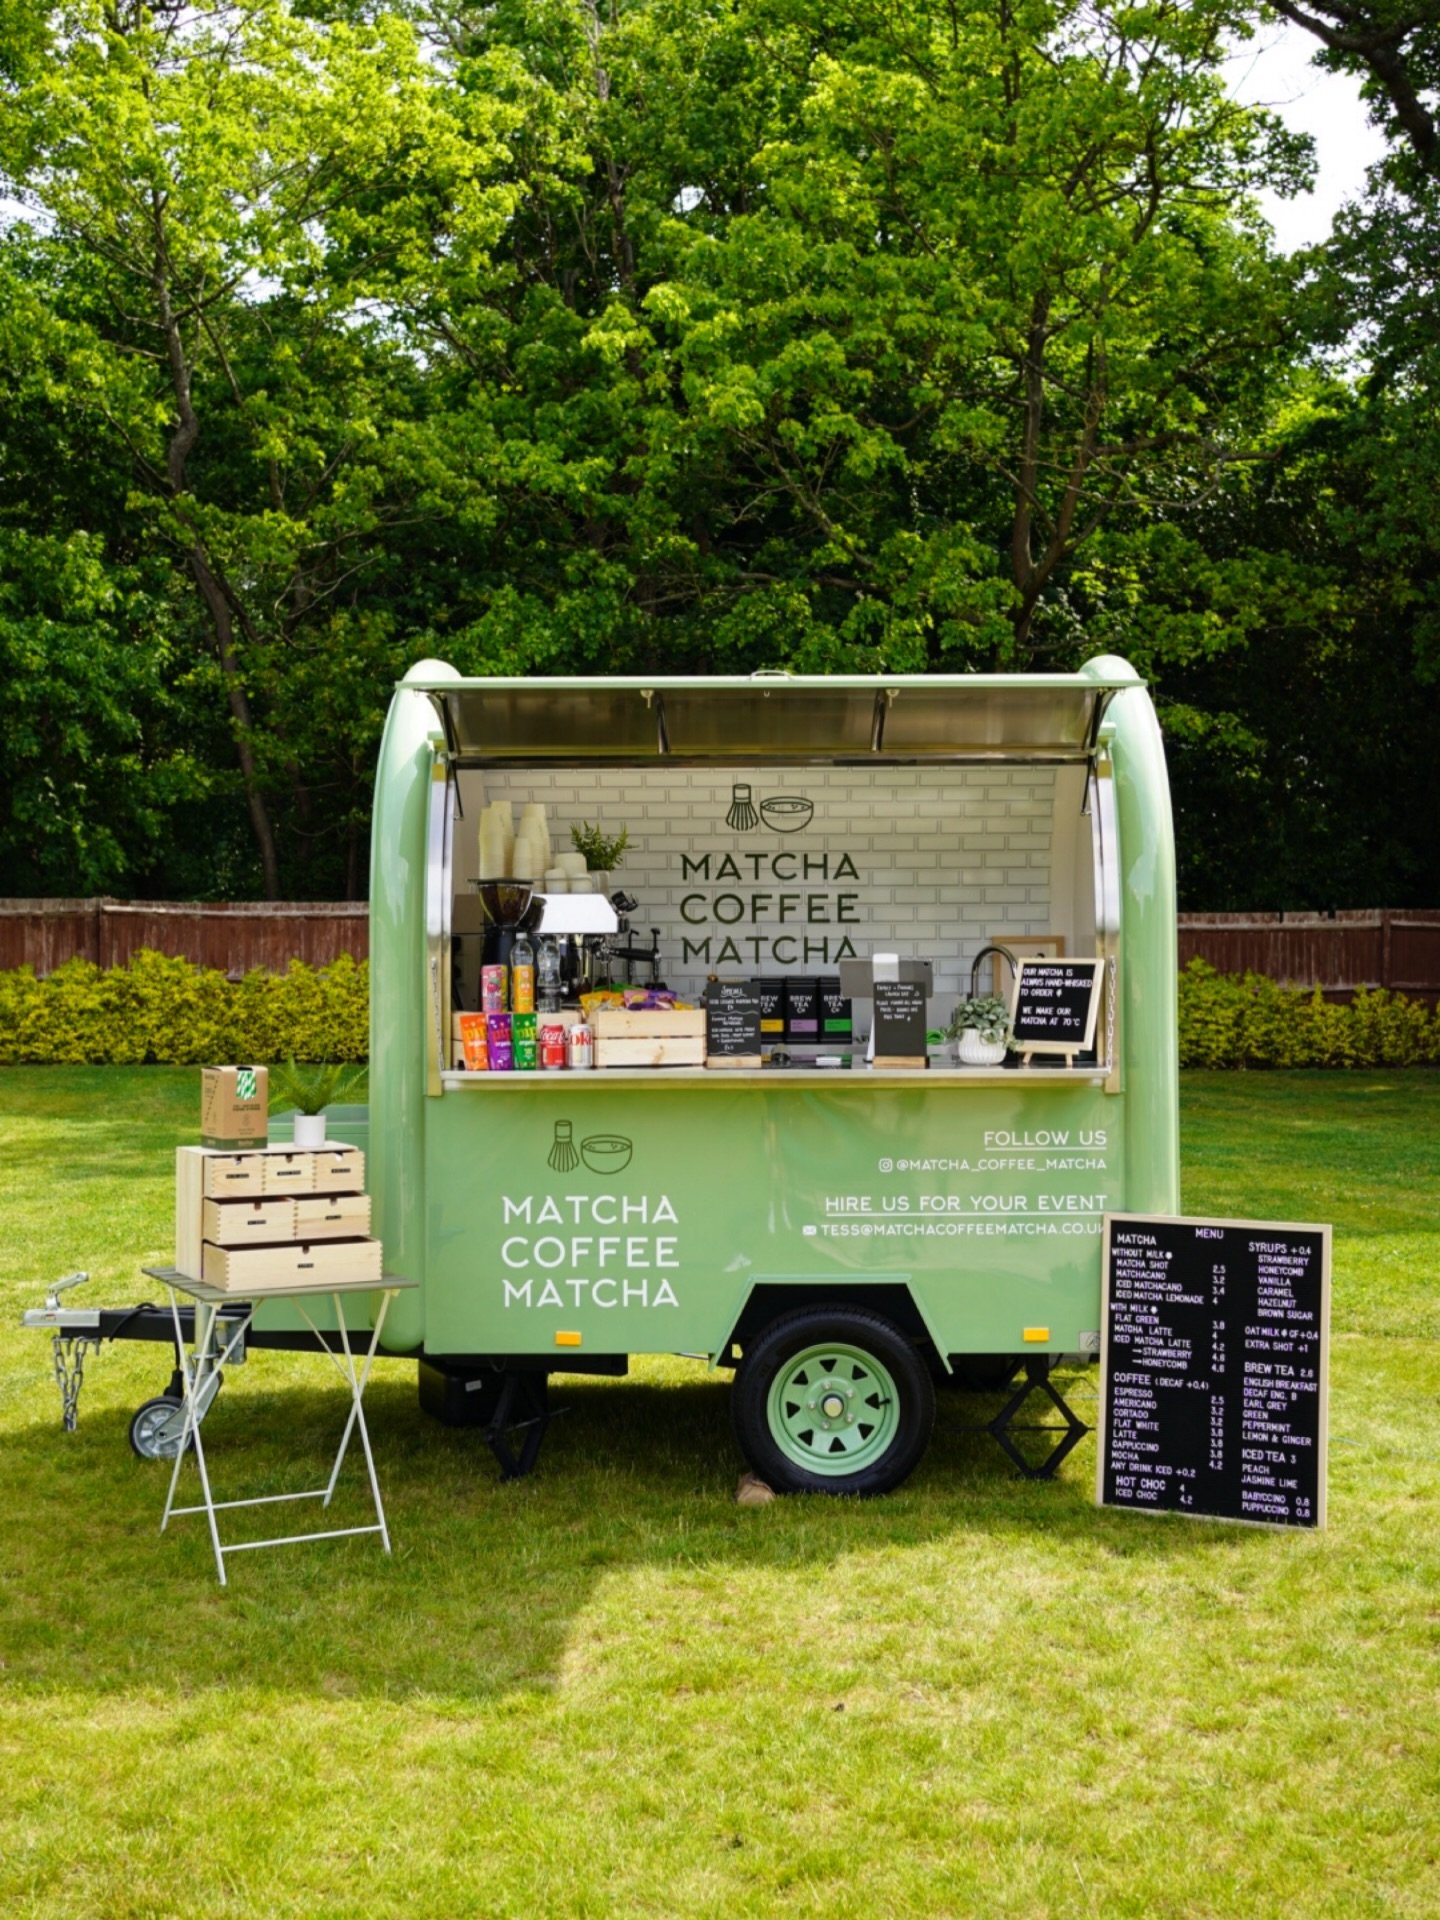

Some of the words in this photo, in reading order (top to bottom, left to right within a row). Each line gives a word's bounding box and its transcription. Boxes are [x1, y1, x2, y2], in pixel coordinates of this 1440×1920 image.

[680, 853, 860, 880] MATCHA
[680, 893, 861, 925] COFFEE
[681, 935, 858, 965] MATCHA
[1037, 968, 1063, 977] MATCHA
[1066, 969, 1073, 977] IS
[1022, 978, 1044, 986] ALWAYS
[1021, 988, 1029, 996] TO
[1030, 988, 1054, 997] ORDER
[1022, 1006, 1033, 1014] WE
[1036, 1006, 1054, 1015] MAKE
[1056, 1007, 1072, 1016] OUR
[1021, 1017, 1047, 1025] MATCHA
[1049, 1017, 1059, 1026] AT
[983, 1130, 1070, 1146] FOLLOW
[1079, 1130, 1107, 1146] US
[896, 1158, 1107, 1172] @MATCHA_COFFEE_MATCHA
[502, 1195, 679, 1224] MATCHA
[825, 1196, 872, 1212] HIRE
[882, 1196, 910, 1211] US
[919, 1196, 961, 1211] FOR
[970, 1196, 1028, 1211] YOUR
[1038, 1195, 1107, 1211] EVENT
[1117, 1233, 1157, 1245] MATCHA
[1195, 1227, 1224, 1239] MENU
[501, 1236, 680, 1268] COFFEE
[1111, 1247, 1143, 1257] WITHOUT
[1146, 1250, 1164, 1259] MILK
[1248, 1241, 1287, 1254] SYRUPS
[1116, 1259, 1146, 1268] MATCHA
[1149, 1261, 1169, 1270] SHOT
[1258, 1254, 1309, 1266] STRAWBERRY
[1116, 1269, 1166, 1280] MATCHACANO
[1258, 1265, 1304, 1277] HONEYCOMB
[1115, 1280, 1132, 1289] ICED
[1134, 1281, 1183, 1292] MATCHACANO
[1258, 1275, 1291, 1286] VANILLA
[502, 1278, 680, 1308] MATCHA
[1115, 1290, 1132, 1299] ICED
[1133, 1291, 1163, 1301] MATCHA
[1165, 1293, 1204, 1304] LEMONADE
[1212, 1296, 1218, 1305] 4
[1257, 1287, 1294, 1298] CARAMEL
[1110, 1303, 1127, 1312] WITH
[1130, 1303, 1149, 1313] MILK
[1258, 1297, 1297, 1308] HAZELNUT
[1115, 1313, 1132, 1322] FLAT
[1135, 1315, 1159, 1325] GREEN
[1257, 1308, 1284, 1318] BROWN
[1286, 1310, 1313, 1320] SUGAR
[1114, 1324, 1143, 1334] MATCHA
[1149, 1326, 1172, 1336] LATTE
[1212, 1331, 1218, 1339] 4
[1244, 1325, 1260, 1335] OAT
[1261, 1327, 1280, 1337] MILK
[1113, 1334, 1130, 1343] ICED
[1134, 1336, 1164, 1346] MATCHA
[1168, 1339, 1192, 1348] LATTE
[1211, 1342, 1225, 1352] 4.2
[1245, 1339, 1270, 1350] EXTRA
[1272, 1341, 1294, 1352] SHOT
[1298, 1343, 1308, 1353] +1
[1142, 1347, 1192, 1359] STRAWBERRY
[1142, 1357, 1188, 1370] HONEYCOMB
[1244, 1361, 1273, 1374] BREW
[1273, 1364, 1295, 1376] TEA
[1113, 1372, 1152, 1385] COFFEE
[1243, 1376, 1274, 1388] ENGLISH
[1275, 1379, 1318, 1392] BREAKFAST
[1114, 1387, 1153, 1398] ESPRESSO
[1243, 1387, 1268, 1398] DECAF
[1113, 1398, 1157, 1409] AMERICANO
[1243, 1398, 1264, 1409] EARL
[1266, 1401, 1288, 1411] GREY
[1113, 1408, 1149, 1419] CORTADO
[1242, 1409, 1269, 1420] GREEN
[1113, 1418, 1132, 1428] FLAT
[1135, 1421, 1159, 1431] WHITE
[1242, 1420, 1291, 1433] PEPPERMINT
[1112, 1429, 1137, 1439] LATTE
[1242, 1431, 1269, 1442] LEMON
[1271, 1434, 1278, 1443] &
[1282, 1435, 1312, 1446] GINGER
[1112, 1440, 1159, 1452] CAPPUCCINO
[1111, 1450, 1139, 1461] MOCHA
[1209, 1460, 1223, 1470] 4.2
[1242, 1448, 1264, 1460] ICED
[1265, 1450, 1286, 1463] TEA
[1290, 1454, 1297, 1464] 3
[1111, 1461, 1126, 1470] ANY
[1129, 1463, 1153, 1473] DRINK
[1155, 1465, 1173, 1475] ICED
[1242, 1463, 1270, 1475] PEACH
[1115, 1475, 1136, 1487] HOT
[1140, 1478, 1166, 1491] CHOC
[1180, 1484, 1185, 1492] 4
[1241, 1474, 1276, 1487] JASMINE
[1279, 1479, 1298, 1490] LIME
[1115, 1488, 1133, 1498] ICED
[1136, 1491, 1158, 1501] CHOC
[1180, 1495, 1193, 1505] 4.2
[1242, 1490, 1286, 1504] BABYCCINO
[1295, 1496, 1310, 1507] 0.8
[1242, 1501, 1290, 1515] PUPPUCCINO
[1295, 1507, 1310, 1518] 0.8
